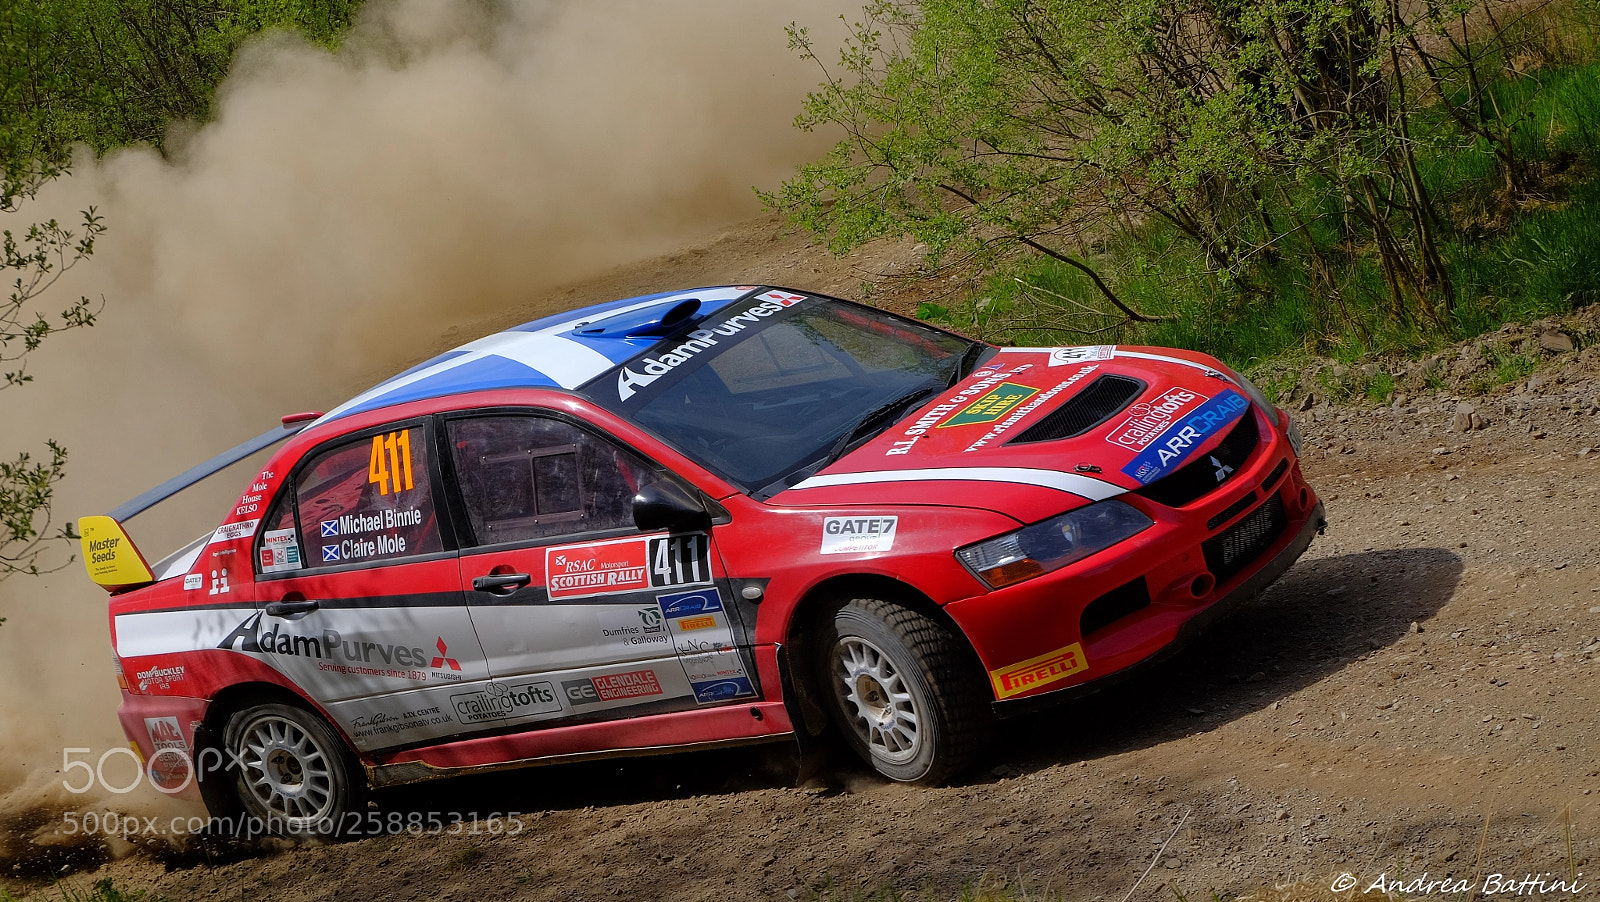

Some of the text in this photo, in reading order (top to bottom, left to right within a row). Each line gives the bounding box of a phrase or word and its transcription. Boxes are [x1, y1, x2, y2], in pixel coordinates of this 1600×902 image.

[618, 300, 784, 403] AdamPurves
[904, 404, 958, 436] SMITH
[949, 395, 968, 403] &
[959, 373, 1013, 395] SONS
[965, 394, 1002, 415] SKIP
[982, 394, 1023, 415] HIRE
[1137, 420, 1170, 446] POTATOES
[368, 428, 415, 496] 411
[261, 470, 275, 480] The
[252, 482, 268, 493] Mole
[242, 494, 263, 505] House
[236, 503, 258, 516] KELSO
[340, 505, 422, 535] Michael Binnie
[826, 519, 895, 535] GATE7
[89, 537, 121, 553] Master
[341, 533, 406, 560] Claire Mole
[91, 548, 116, 564] Seeds
[654, 535, 701, 585] 411
[565, 558, 629, 573] RSAC Motorsport
[551, 568, 645, 592] SCOTTISH RALLY
[602, 626, 640, 637] Dumfries
[680, 617, 714, 630] PIRELLI
[216, 610, 428, 668] AdamPurves
[623, 634, 668, 646] & Galloway
[154, 666, 185, 677] BUCKLEY
[318, 661, 428, 681] Serving customers since 1879
[431, 671, 463, 680] MITSUBISHI
[1000, 651, 1079, 692] PIRELLI
[597, 671, 655, 690] GLENDALE
[566, 683, 597, 700] GE
[600, 682, 660, 700] ENGINEERING
[457, 685, 554, 715] crailingtofts
[417, 707, 441, 717] CENTRE
[468, 709, 507, 721] POTATOES
[353, 714, 454, 738] www.frankgibsonatv.co.uk
[155, 741, 186, 750] TOOLS
